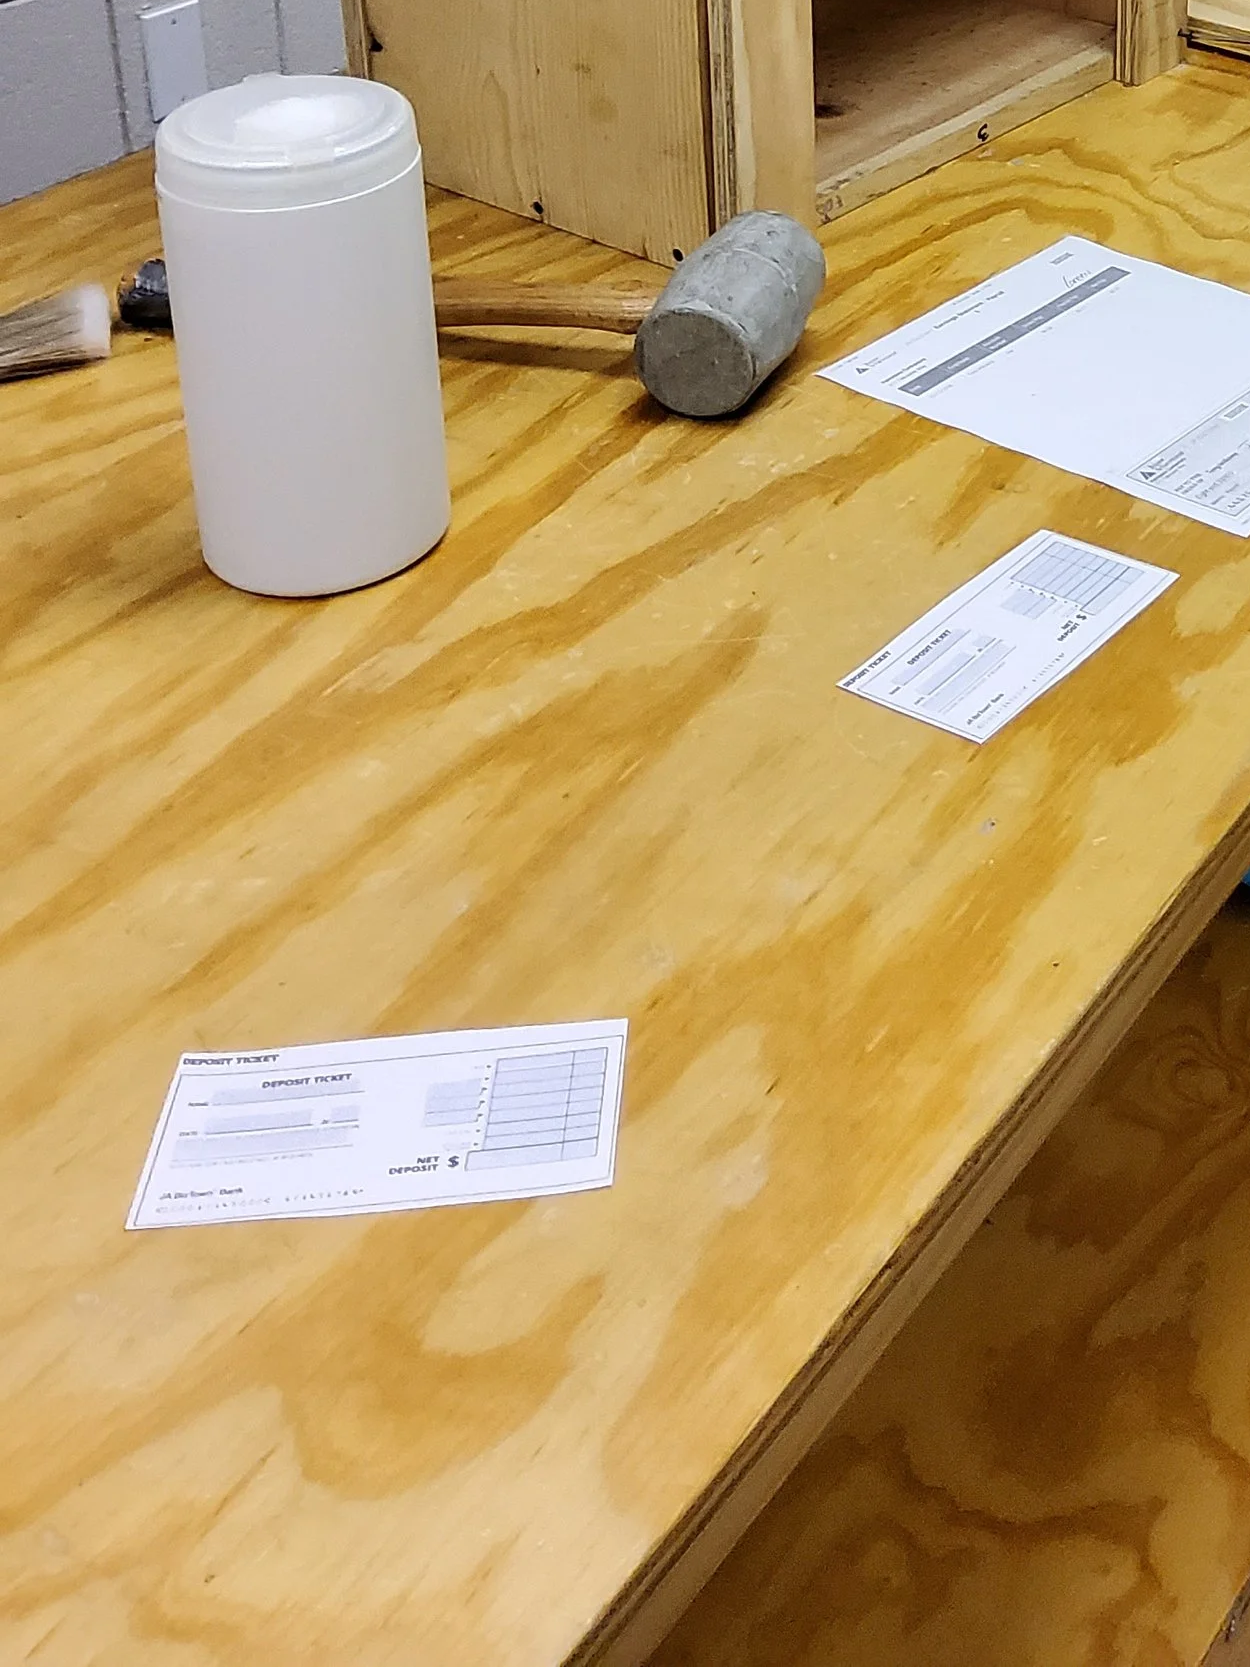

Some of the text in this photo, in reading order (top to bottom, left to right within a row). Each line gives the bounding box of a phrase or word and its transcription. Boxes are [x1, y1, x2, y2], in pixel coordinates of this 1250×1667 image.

[183, 1054, 280, 1065] DEPOSIT TICKET
[262, 1073, 352, 1089] DEPOSIT TICKET
[388, 1156, 460, 1175] DEPOSIT $
[417, 1156, 440, 1164] NET
